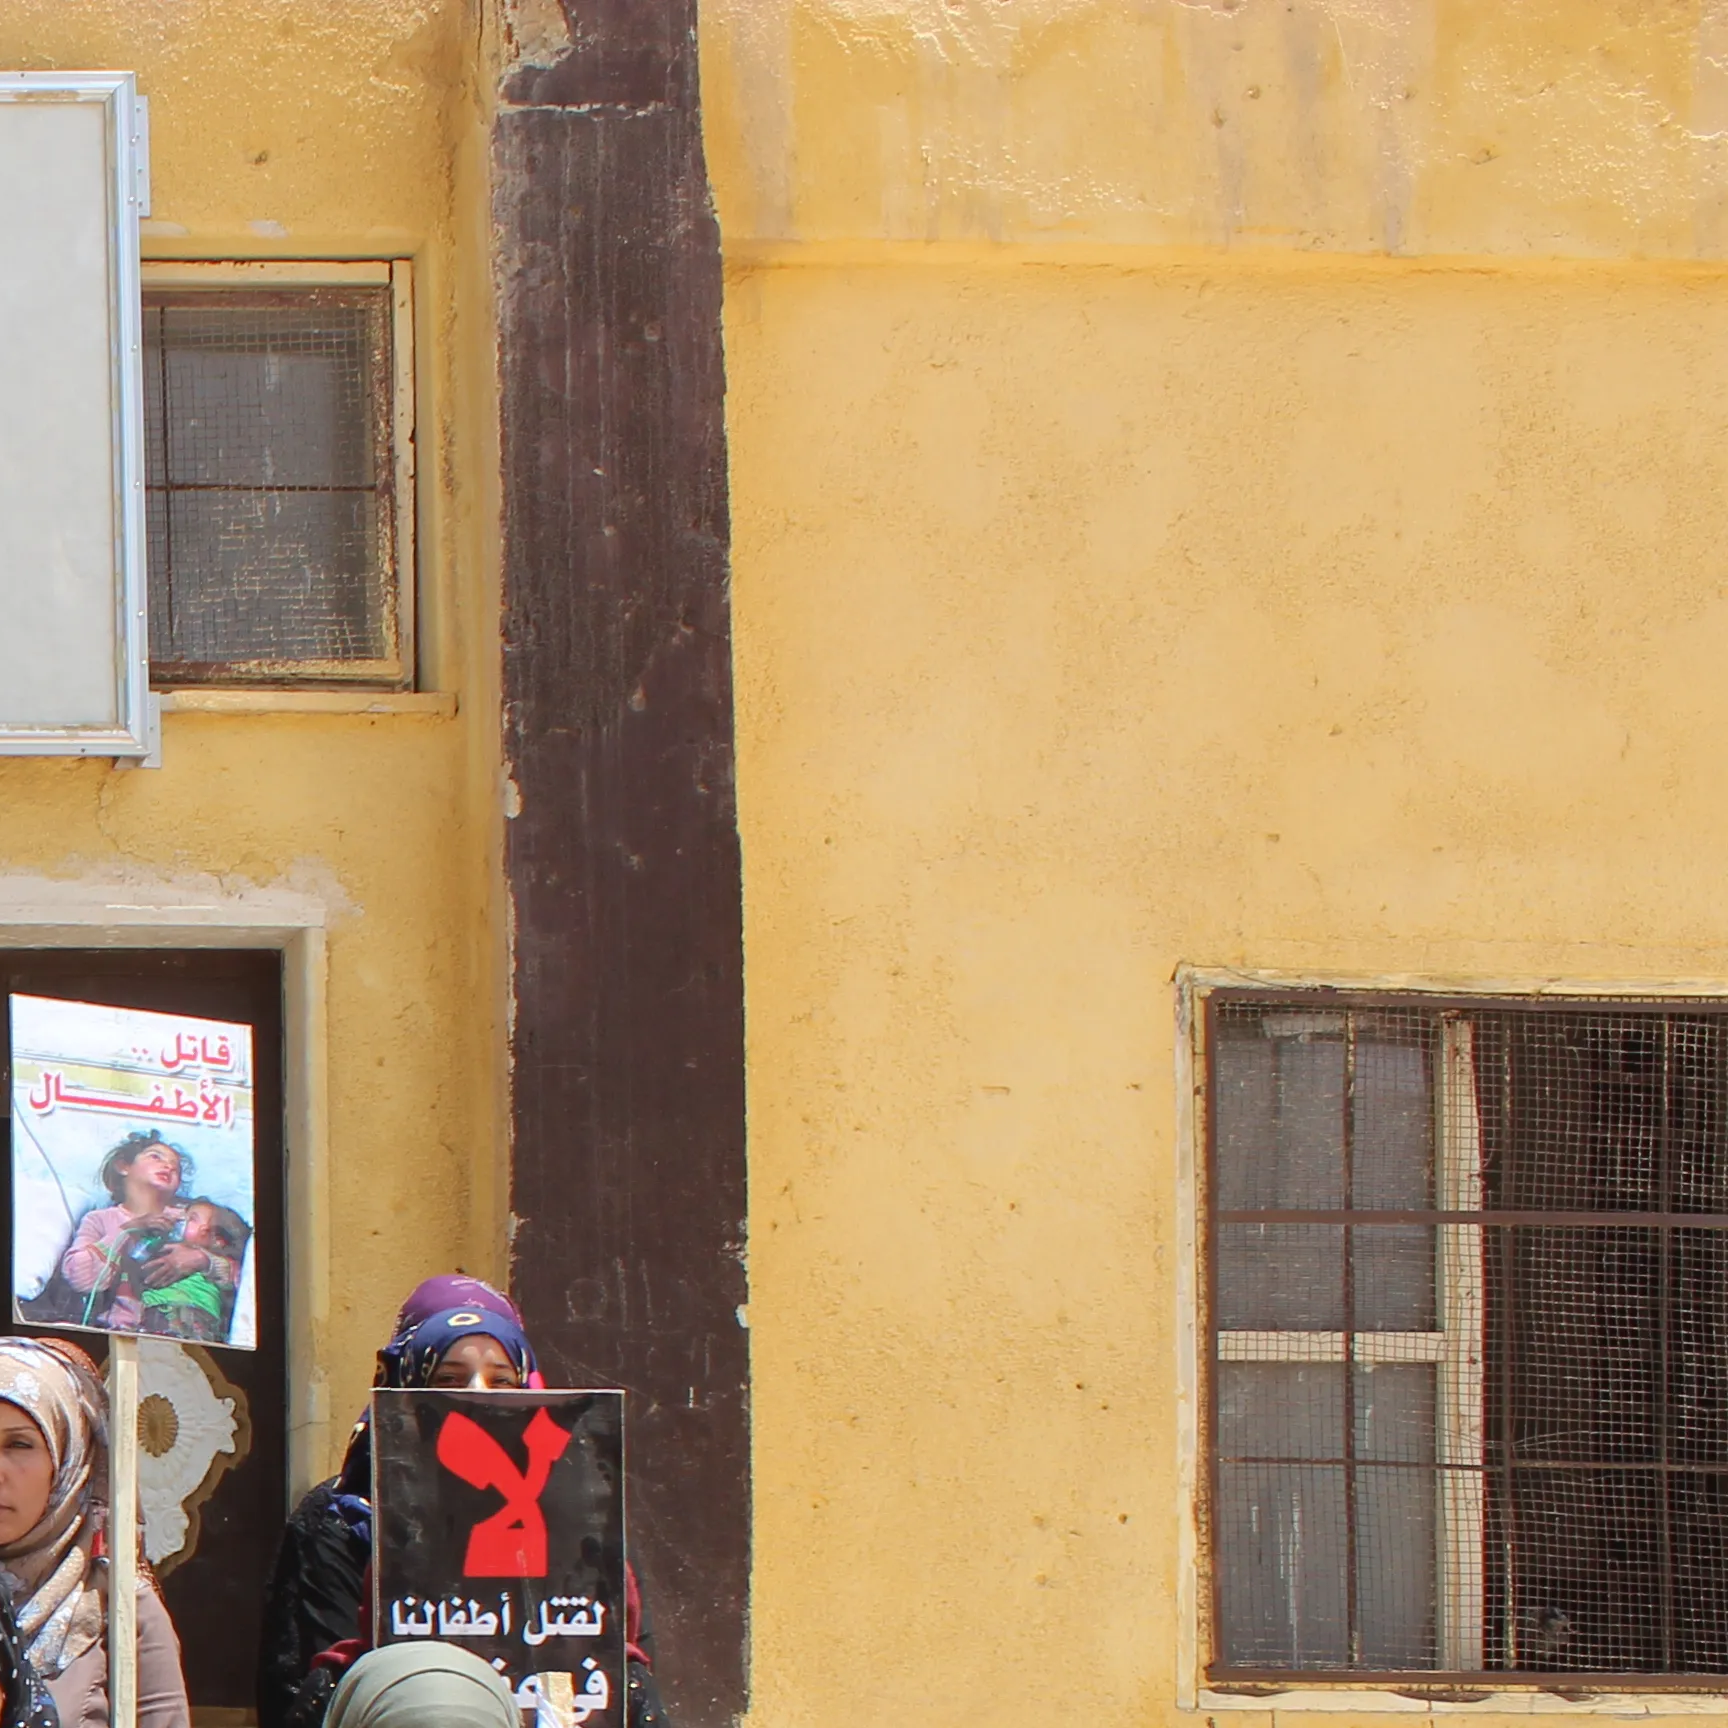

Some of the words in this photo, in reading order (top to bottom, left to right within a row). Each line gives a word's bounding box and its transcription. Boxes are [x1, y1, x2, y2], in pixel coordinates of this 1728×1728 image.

[435, 1405, 573, 1578] لا
[391, 1591, 513, 1637] أطفالنا
[522, 1595, 607, 1647] لقتل
